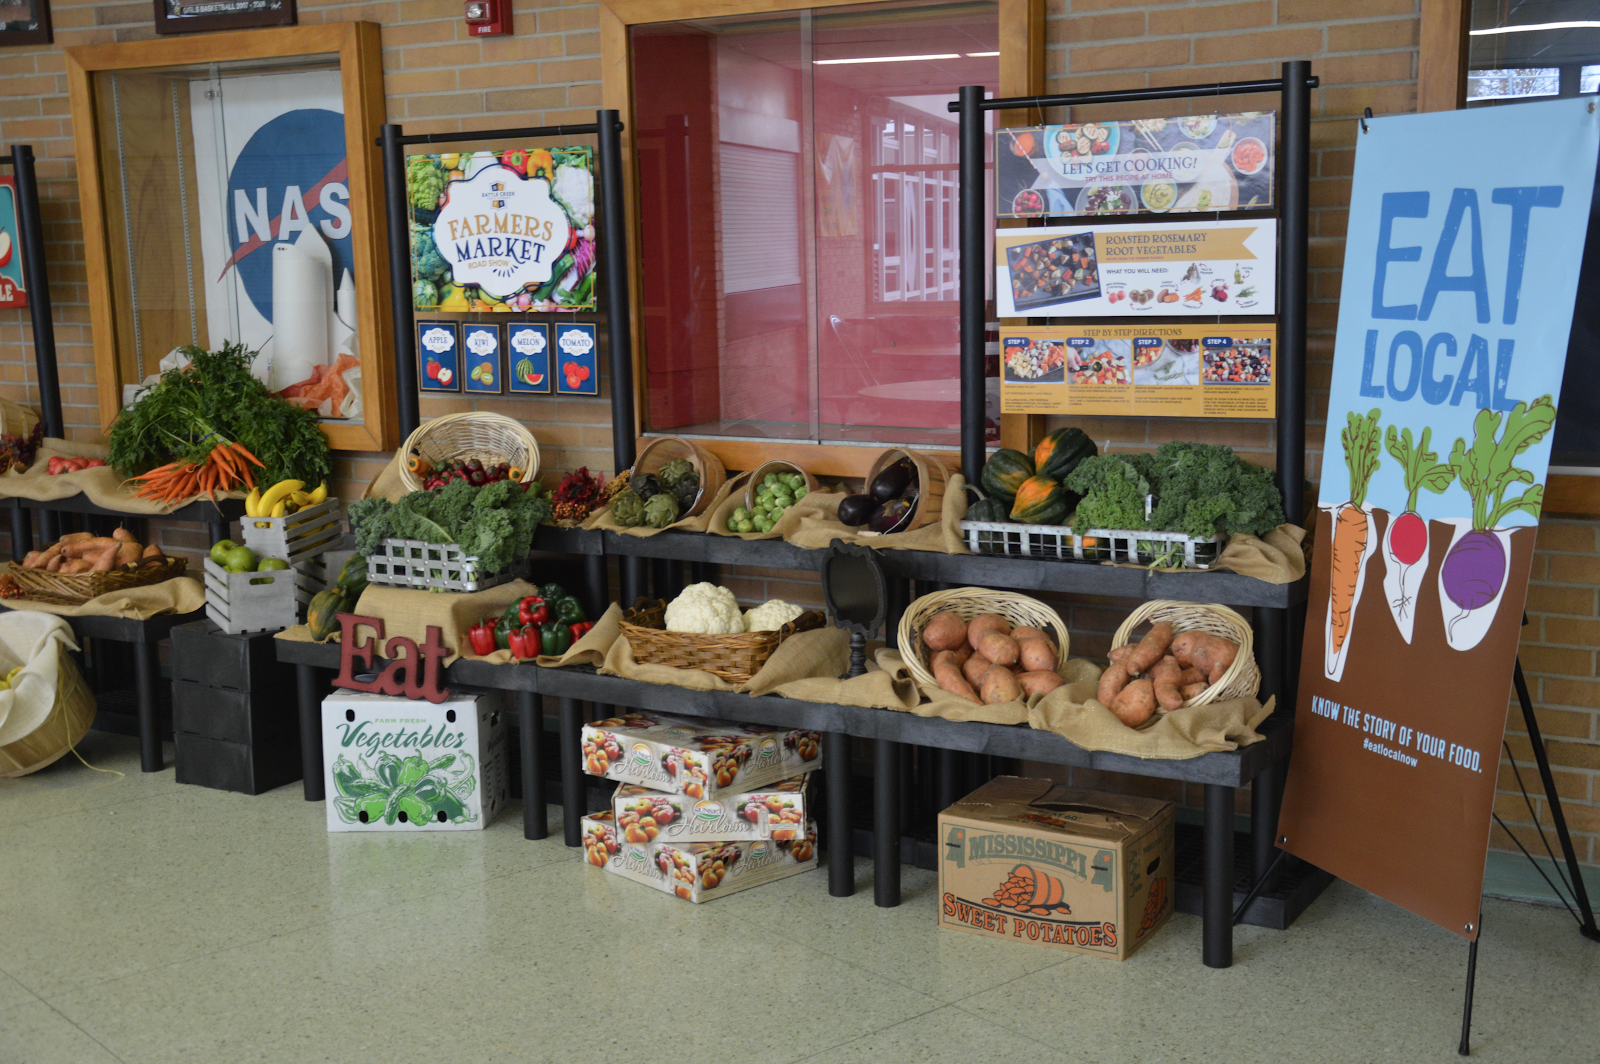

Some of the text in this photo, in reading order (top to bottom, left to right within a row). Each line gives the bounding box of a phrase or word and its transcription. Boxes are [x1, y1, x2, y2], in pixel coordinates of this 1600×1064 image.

[183, 6, 199, 14] GIRLS
[200, 3, 235, 13] BASKETBALL
[1062, 156, 1198, 175] LET'S GET COOKING!
[1151, 172, 1174, 180] HOME
[447, 212, 553, 242] FARMERS
[1105, 232, 1208, 245] ROASTED ROSEMARY
[455, 237, 546, 265] MARKET
[1105, 244, 1197, 256] ROOT VEGETABLES
[1370, 185, 1564, 325] EAT
[468, 259, 509, 270] ROAD SHOW
[428, 336, 448, 344] APPLE
[1133, 328, 1182, 336] DIRECTIONS
[474, 338, 489, 347] KIWI
[517, 338, 540, 346] MELON
[562, 338, 591, 347] TOMATO
[1359, 329, 1523, 411] LOCAL
[331, 611, 451, 705] Eat
[335, 720, 468, 758] Vegetables
[1311, 695, 1482, 773] KNOW THE STORY OF YOUR FOOD.
[1363, 737, 1418, 768] #eatlocalnow
[693, 807, 724, 815] SUNSET
[667, 813, 749, 837] Heirloom
[968, 834, 1087, 881] MISSISSIPPI
[943, 892, 1118, 948] SWEET POTATOES
